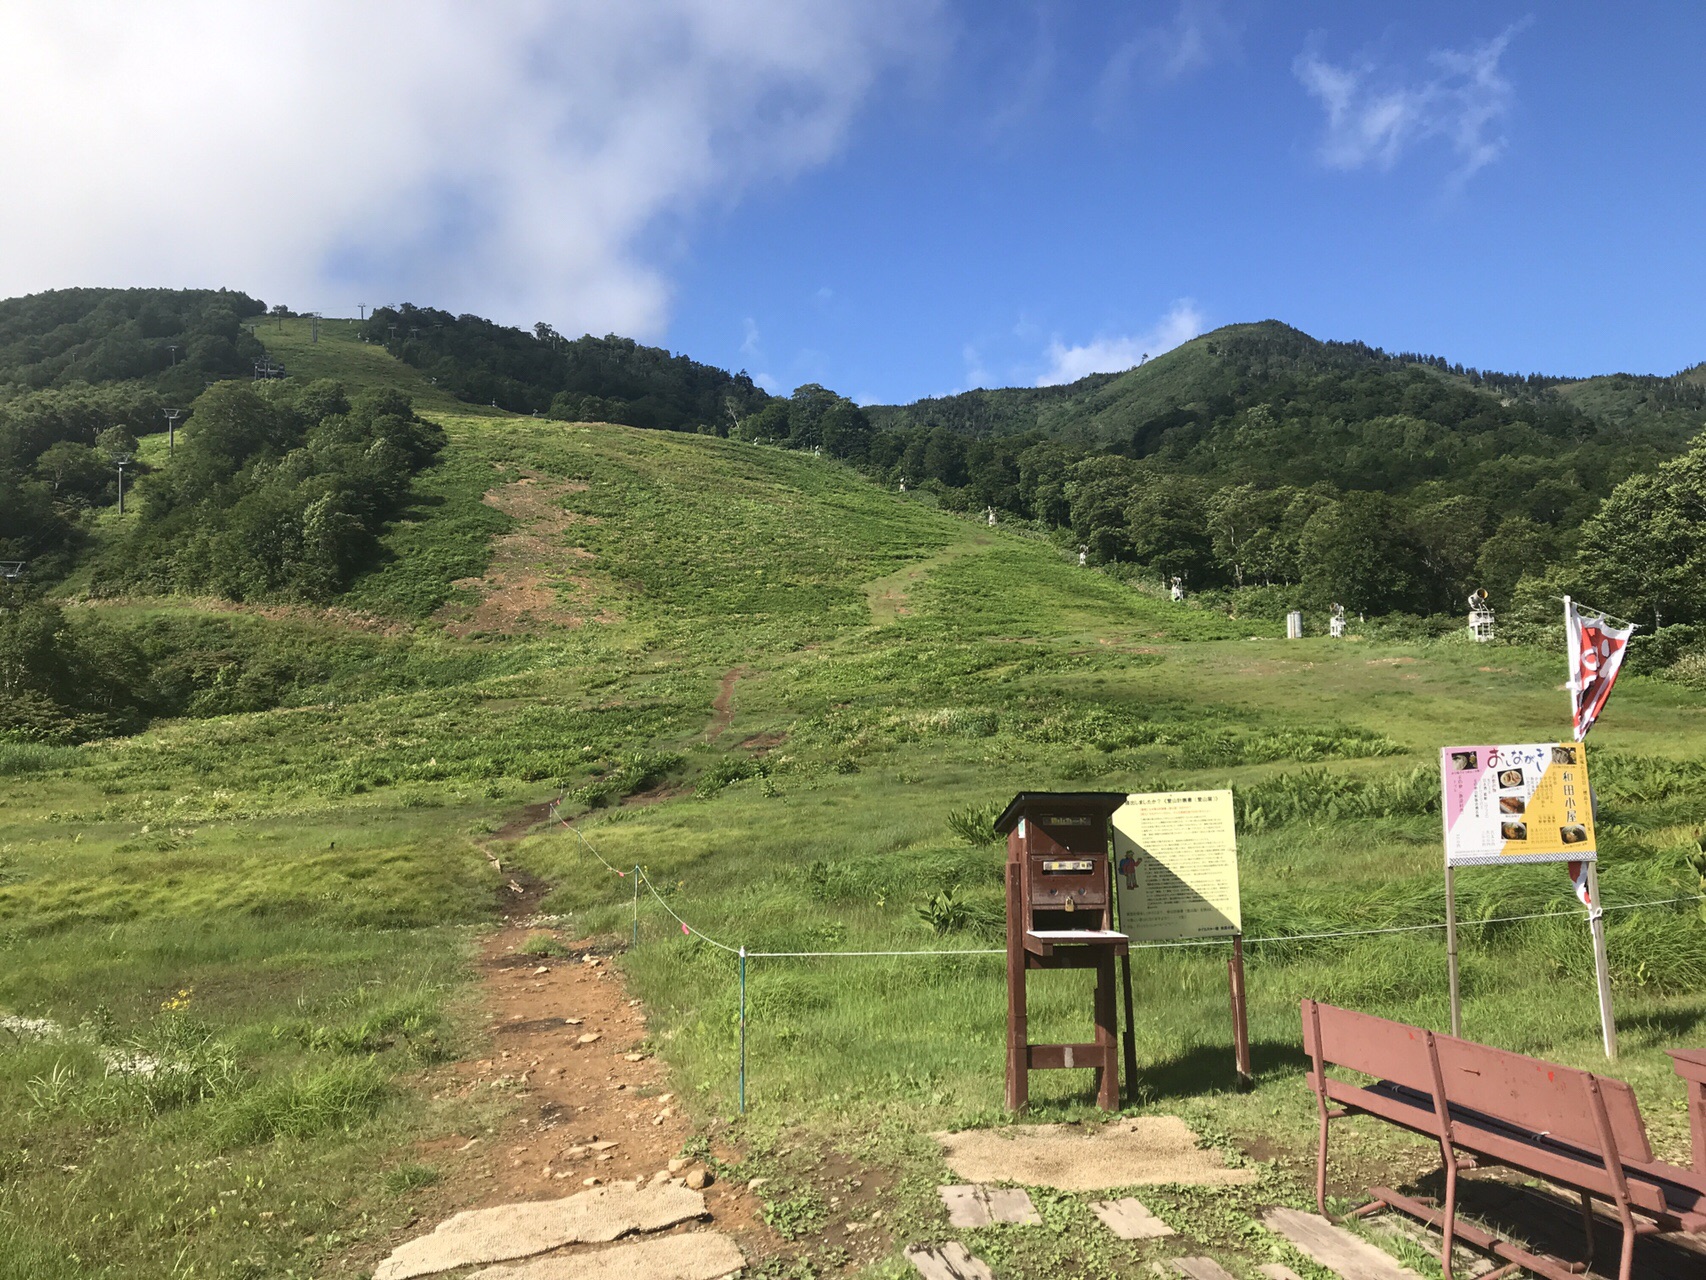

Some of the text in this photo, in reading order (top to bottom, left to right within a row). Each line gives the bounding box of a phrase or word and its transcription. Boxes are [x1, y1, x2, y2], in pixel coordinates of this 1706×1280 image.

[1487, 748, 1544, 773] おしながき
[1563, 771, 1577, 823] 和田小屋
